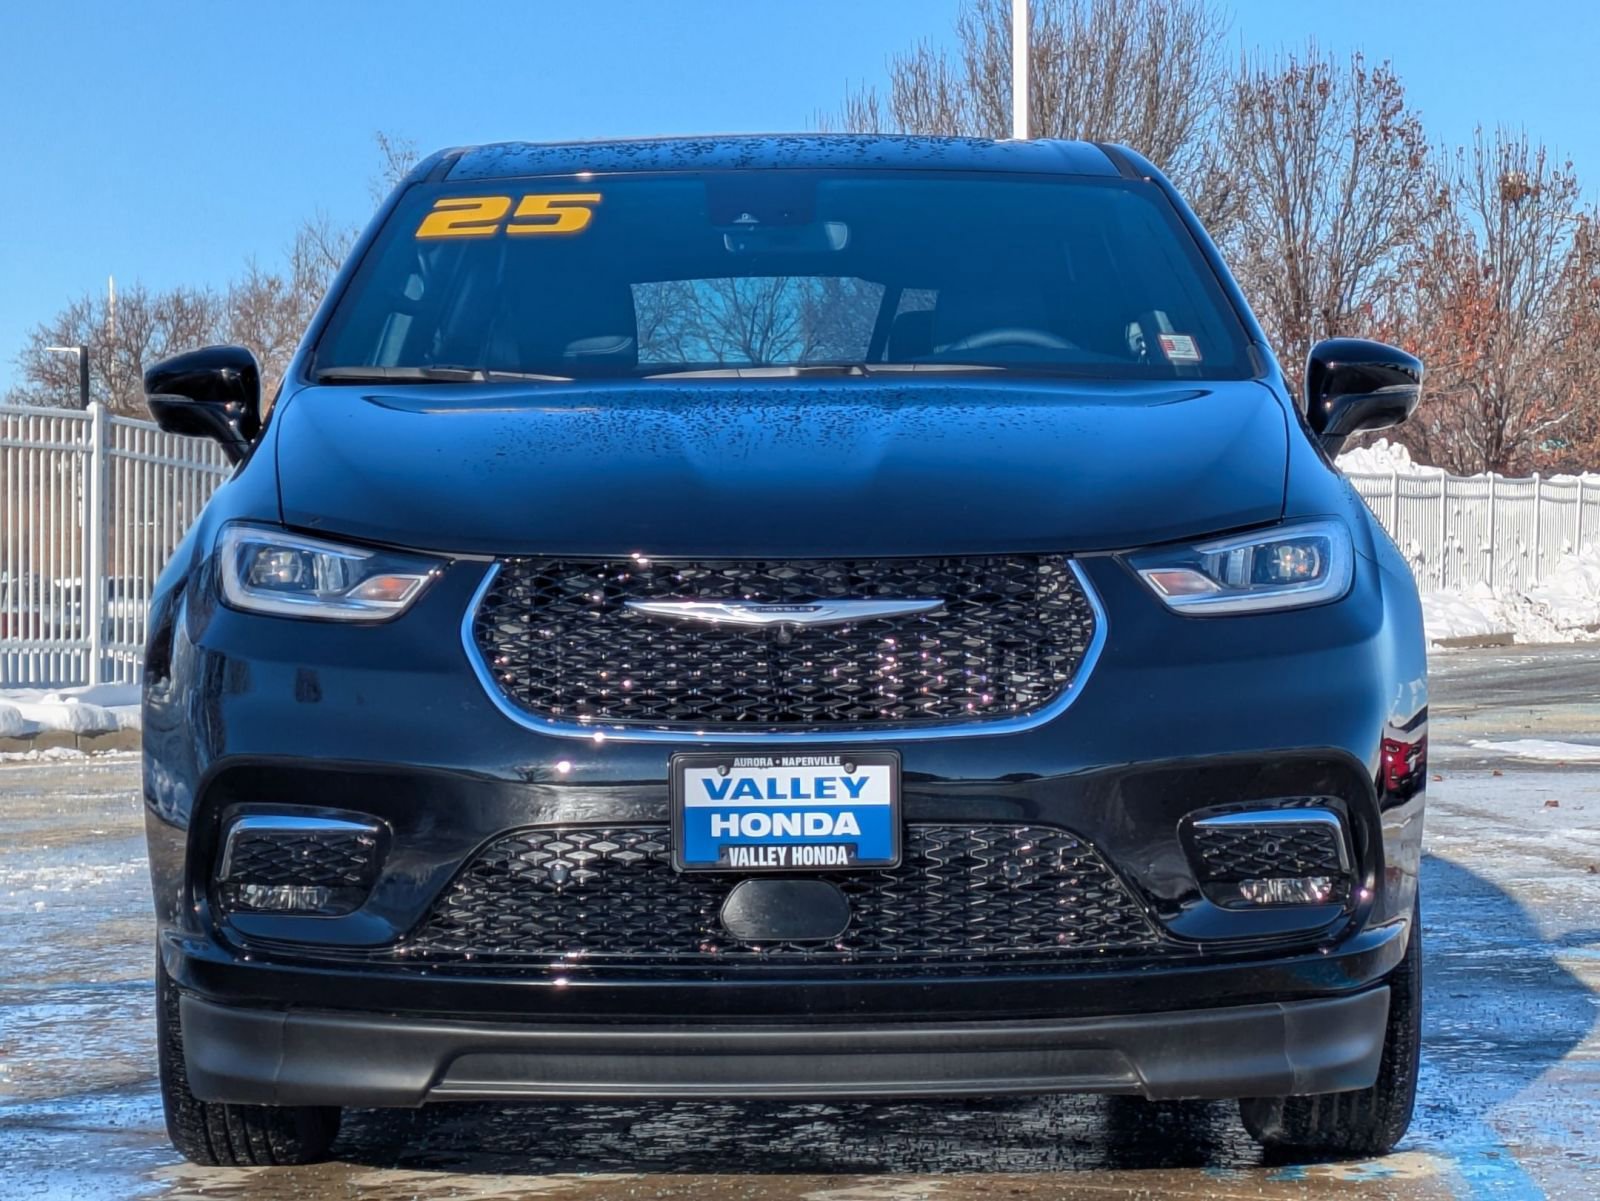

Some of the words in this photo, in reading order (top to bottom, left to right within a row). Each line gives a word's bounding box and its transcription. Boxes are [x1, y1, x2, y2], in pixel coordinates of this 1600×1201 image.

[415, 193, 602, 238] 25
[733, 757, 773, 767] AURORA
[782, 756, 840, 767] NAPERVILLE
[701, 776, 870, 800] VALLEY
[711, 812, 861, 837] HONDA
[728, 847, 787, 867] VALLEY
[792, 846, 848, 865] HONDA
